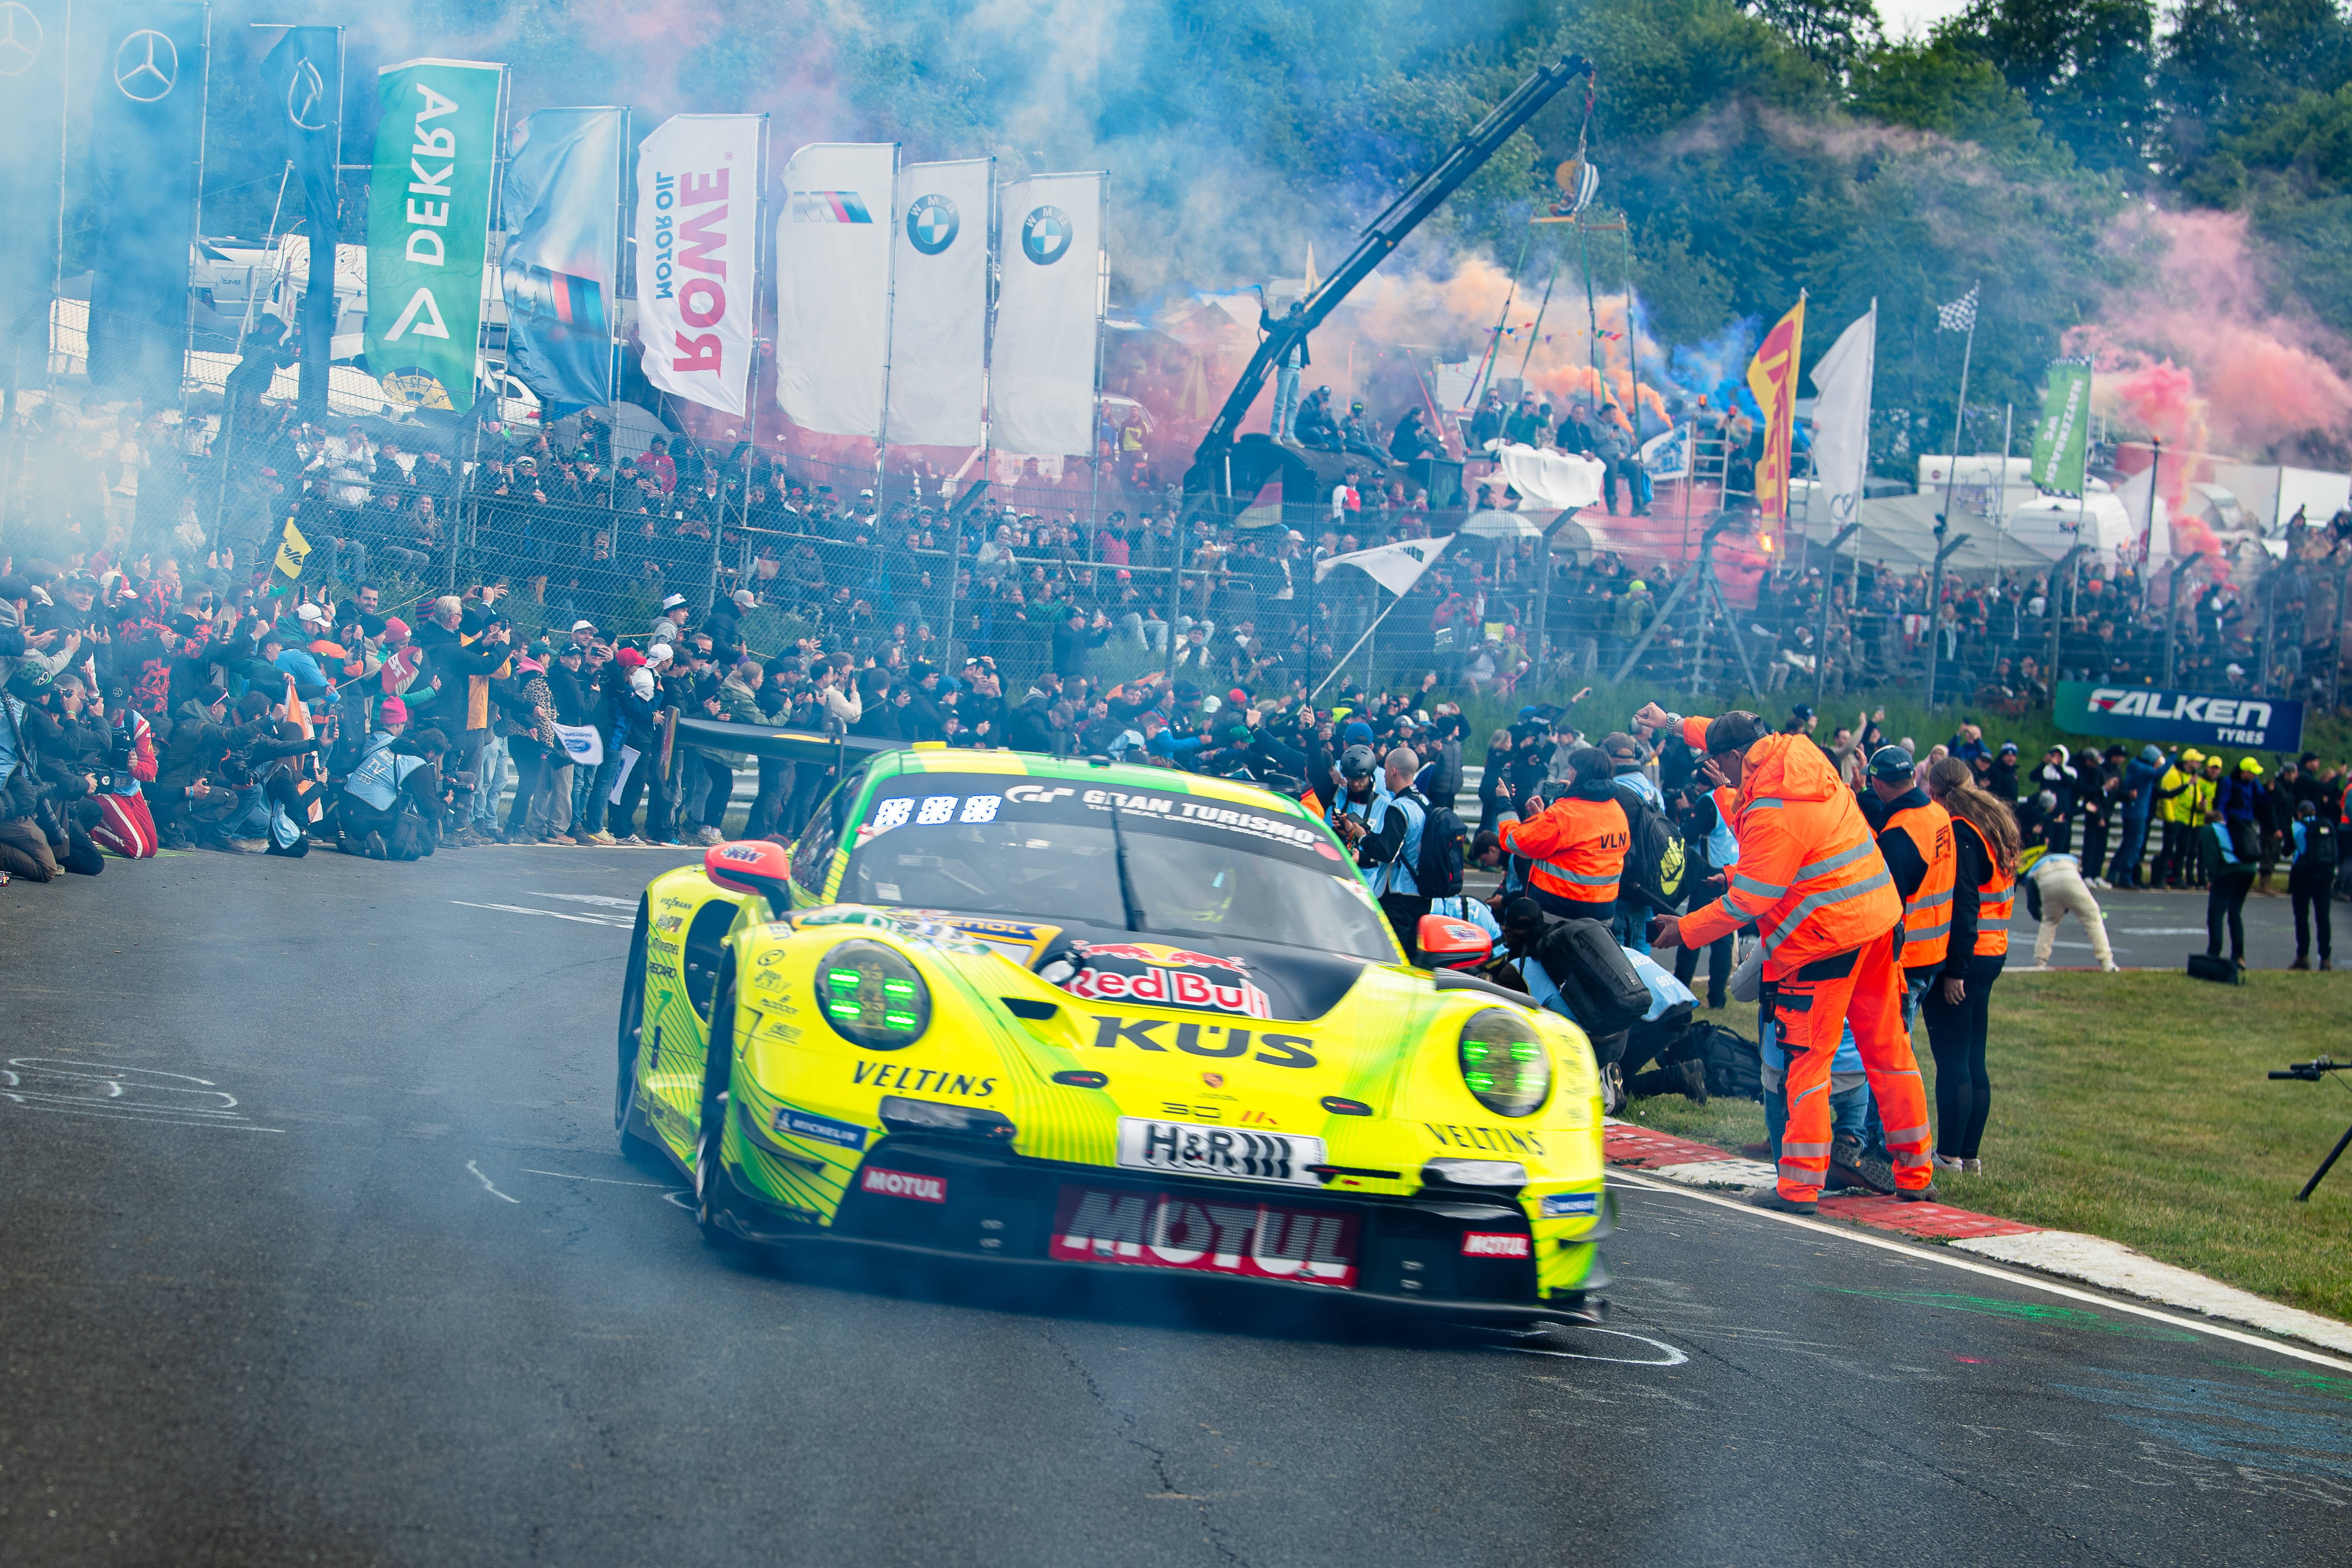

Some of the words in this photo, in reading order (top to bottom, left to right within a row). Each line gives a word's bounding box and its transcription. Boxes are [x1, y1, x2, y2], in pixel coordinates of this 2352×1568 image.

[2045, 378, 2084, 484] HATZENBACH
[2088, 688, 2273, 729] FALKEN
[2217, 728, 2265, 745] TYRES
[1082, 790, 1173, 813] GRAN
[1181, 802, 1315, 844] TURISMO
[1601, 832, 1627, 849] VLN
[660, 897, 693, 910] VIESSMANN
[648, 961, 677, 979] RECARO
[1063, 968, 1169, 999] Red
[1174, 972, 1271, 1019] Bull
[1091, 1016, 1318, 1068] KÜS
[850, 1060, 998, 1097] VELTINS
[790, 1119, 858, 1143] MICHELIN
[1424, 1123, 1545, 1156] VELTINS
[1144, 1124, 1247, 1174] H&R
[864, 1171, 943, 1200] MOTUL
[1062, 1191, 1350, 1279] MOTUL
[1463, 1234, 1529, 1256] MOTUL
